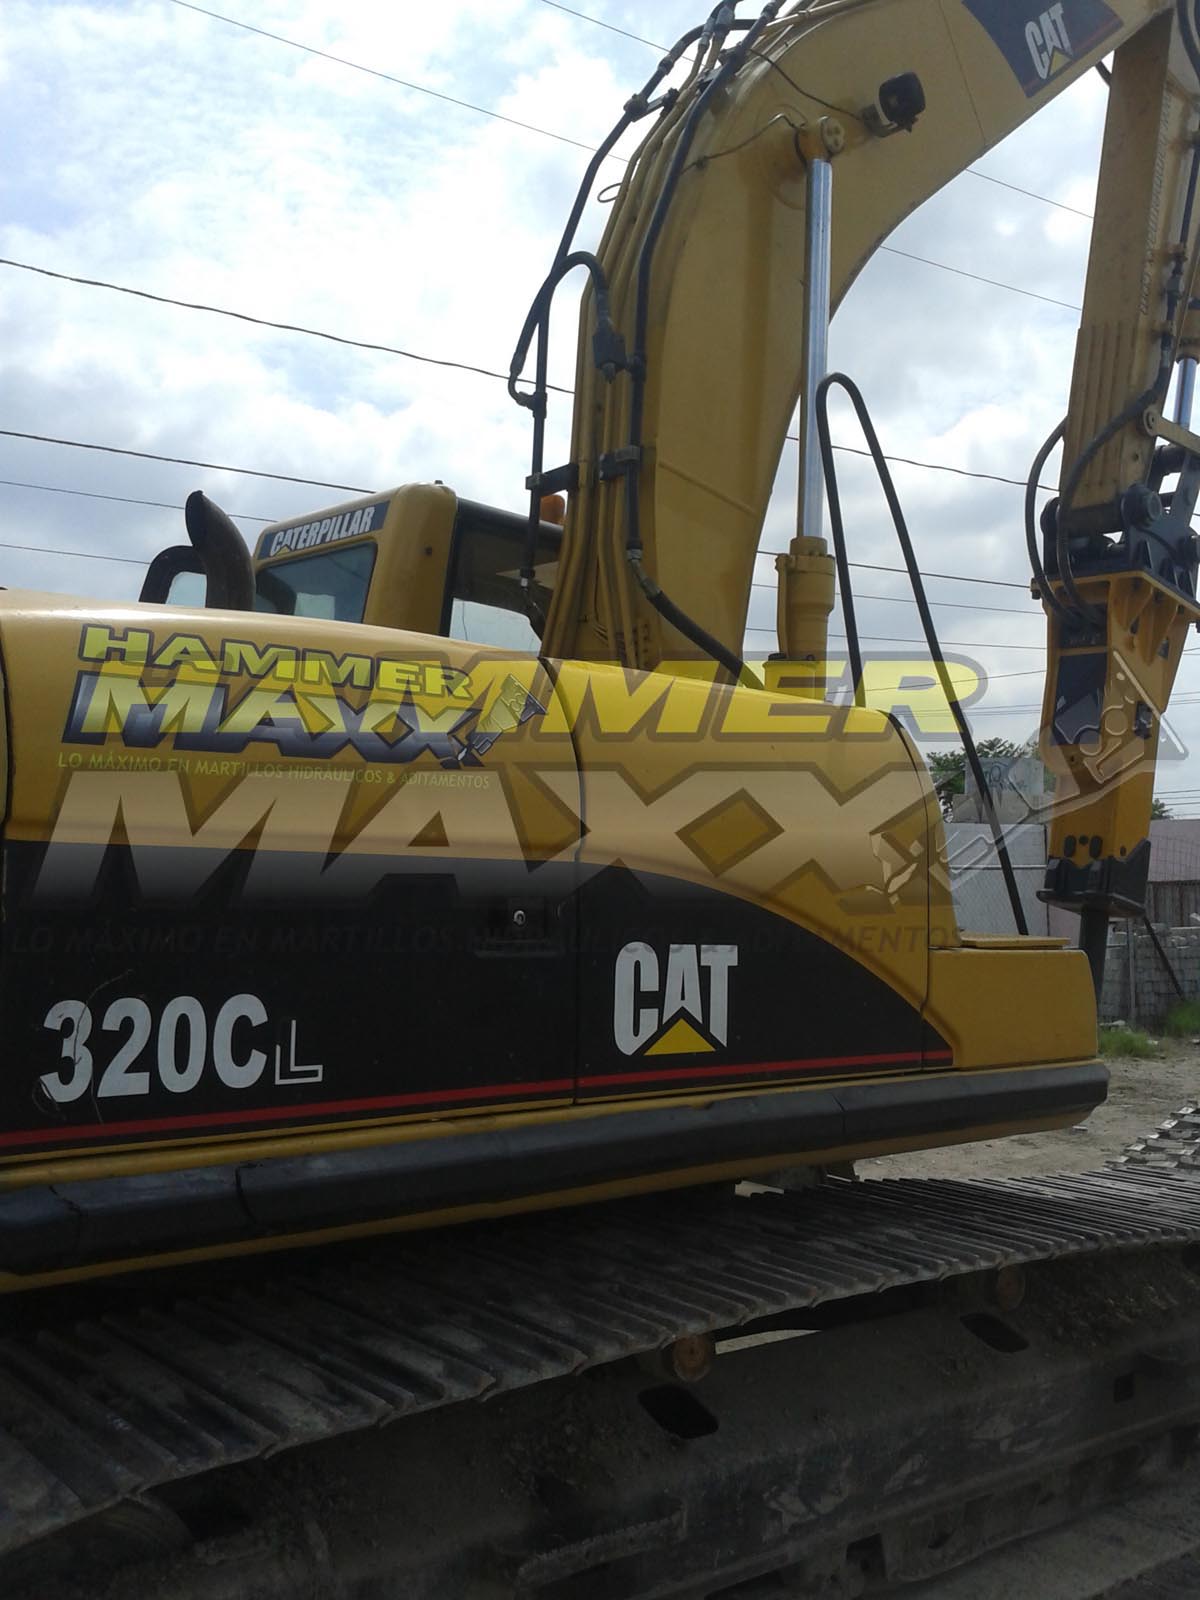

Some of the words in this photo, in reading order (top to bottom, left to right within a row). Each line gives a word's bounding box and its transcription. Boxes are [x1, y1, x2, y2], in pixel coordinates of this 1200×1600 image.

[1025, 2, 1073, 79] CAT
[270, 507, 375, 557] CATERPILLAR
[79, 624, 470, 698] HAMMER
[62, 671, 484, 768] MAXX
[58, 752, 81, 768] LO
[89, 751, 161, 772] MÁXIMO
[167, 757, 189, 773] EN
[195, 760, 283, 779] MARTILLOS
[400, 772, 489, 789] ADITAMENTOS
[614, 941, 738, 1055] CAT
[40, 993, 268, 1102] 320C
